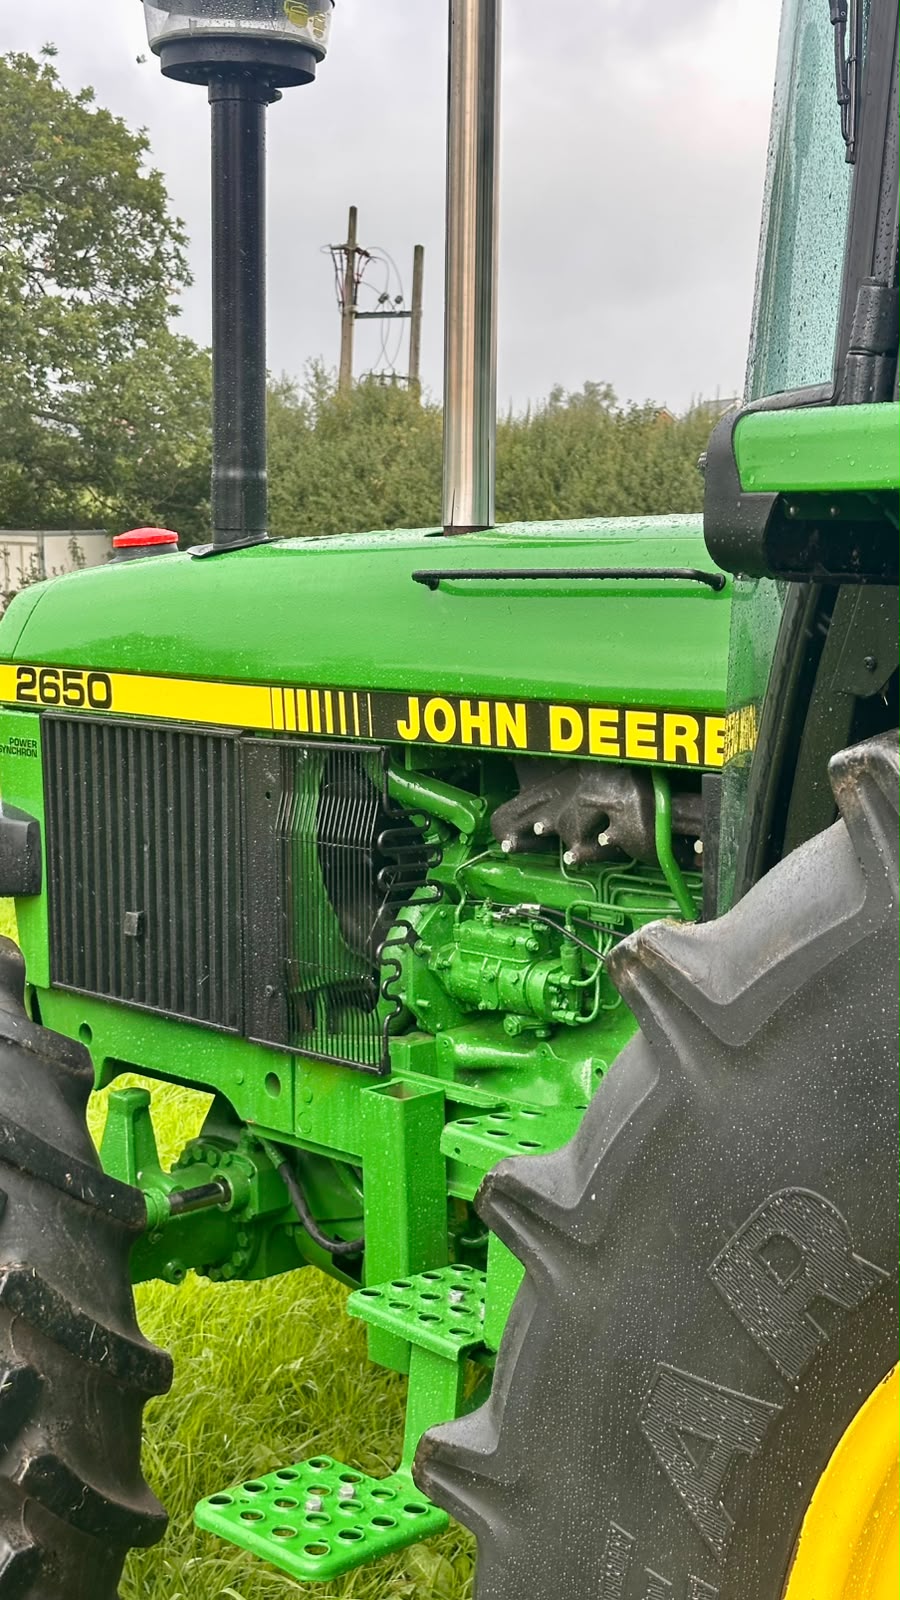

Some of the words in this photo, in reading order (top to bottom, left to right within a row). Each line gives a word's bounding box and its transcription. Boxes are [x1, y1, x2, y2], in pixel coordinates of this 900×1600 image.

[16, 666, 112, 709] 2650
[9, 737, 38, 748] POWER
[397, 696, 528, 749] JOHN
[549, 705, 727, 766] DEERE
